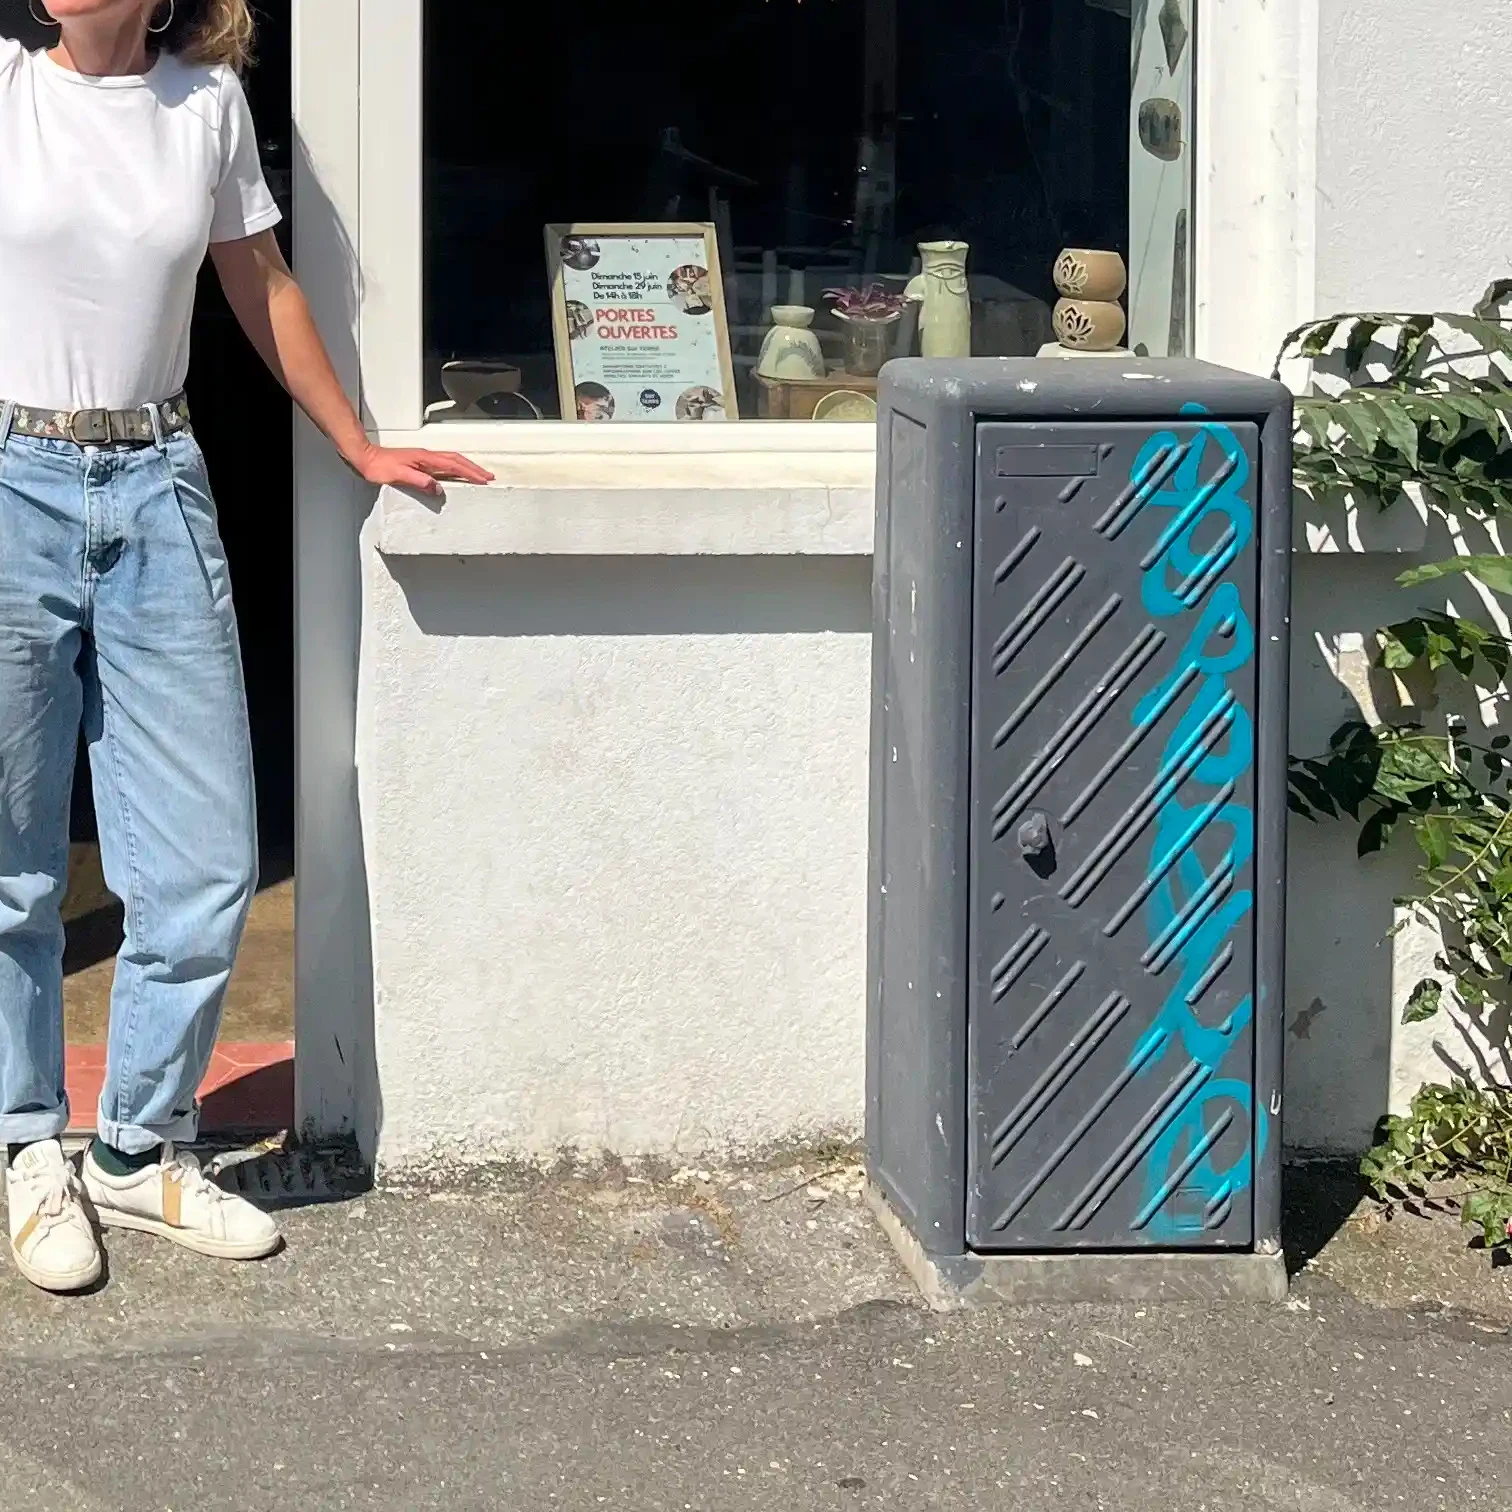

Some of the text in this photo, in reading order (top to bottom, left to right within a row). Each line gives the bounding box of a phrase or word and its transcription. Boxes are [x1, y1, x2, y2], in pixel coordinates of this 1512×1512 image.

[591, 272, 632, 281] Dimanche
[641, 272, 659, 284] juin
[592, 282, 663, 292] Dimanche 29 juin
[593, 291, 605, 300] De
[595, 308, 656, 322] PORTES
[597, 325, 678, 339] OUVERTES
